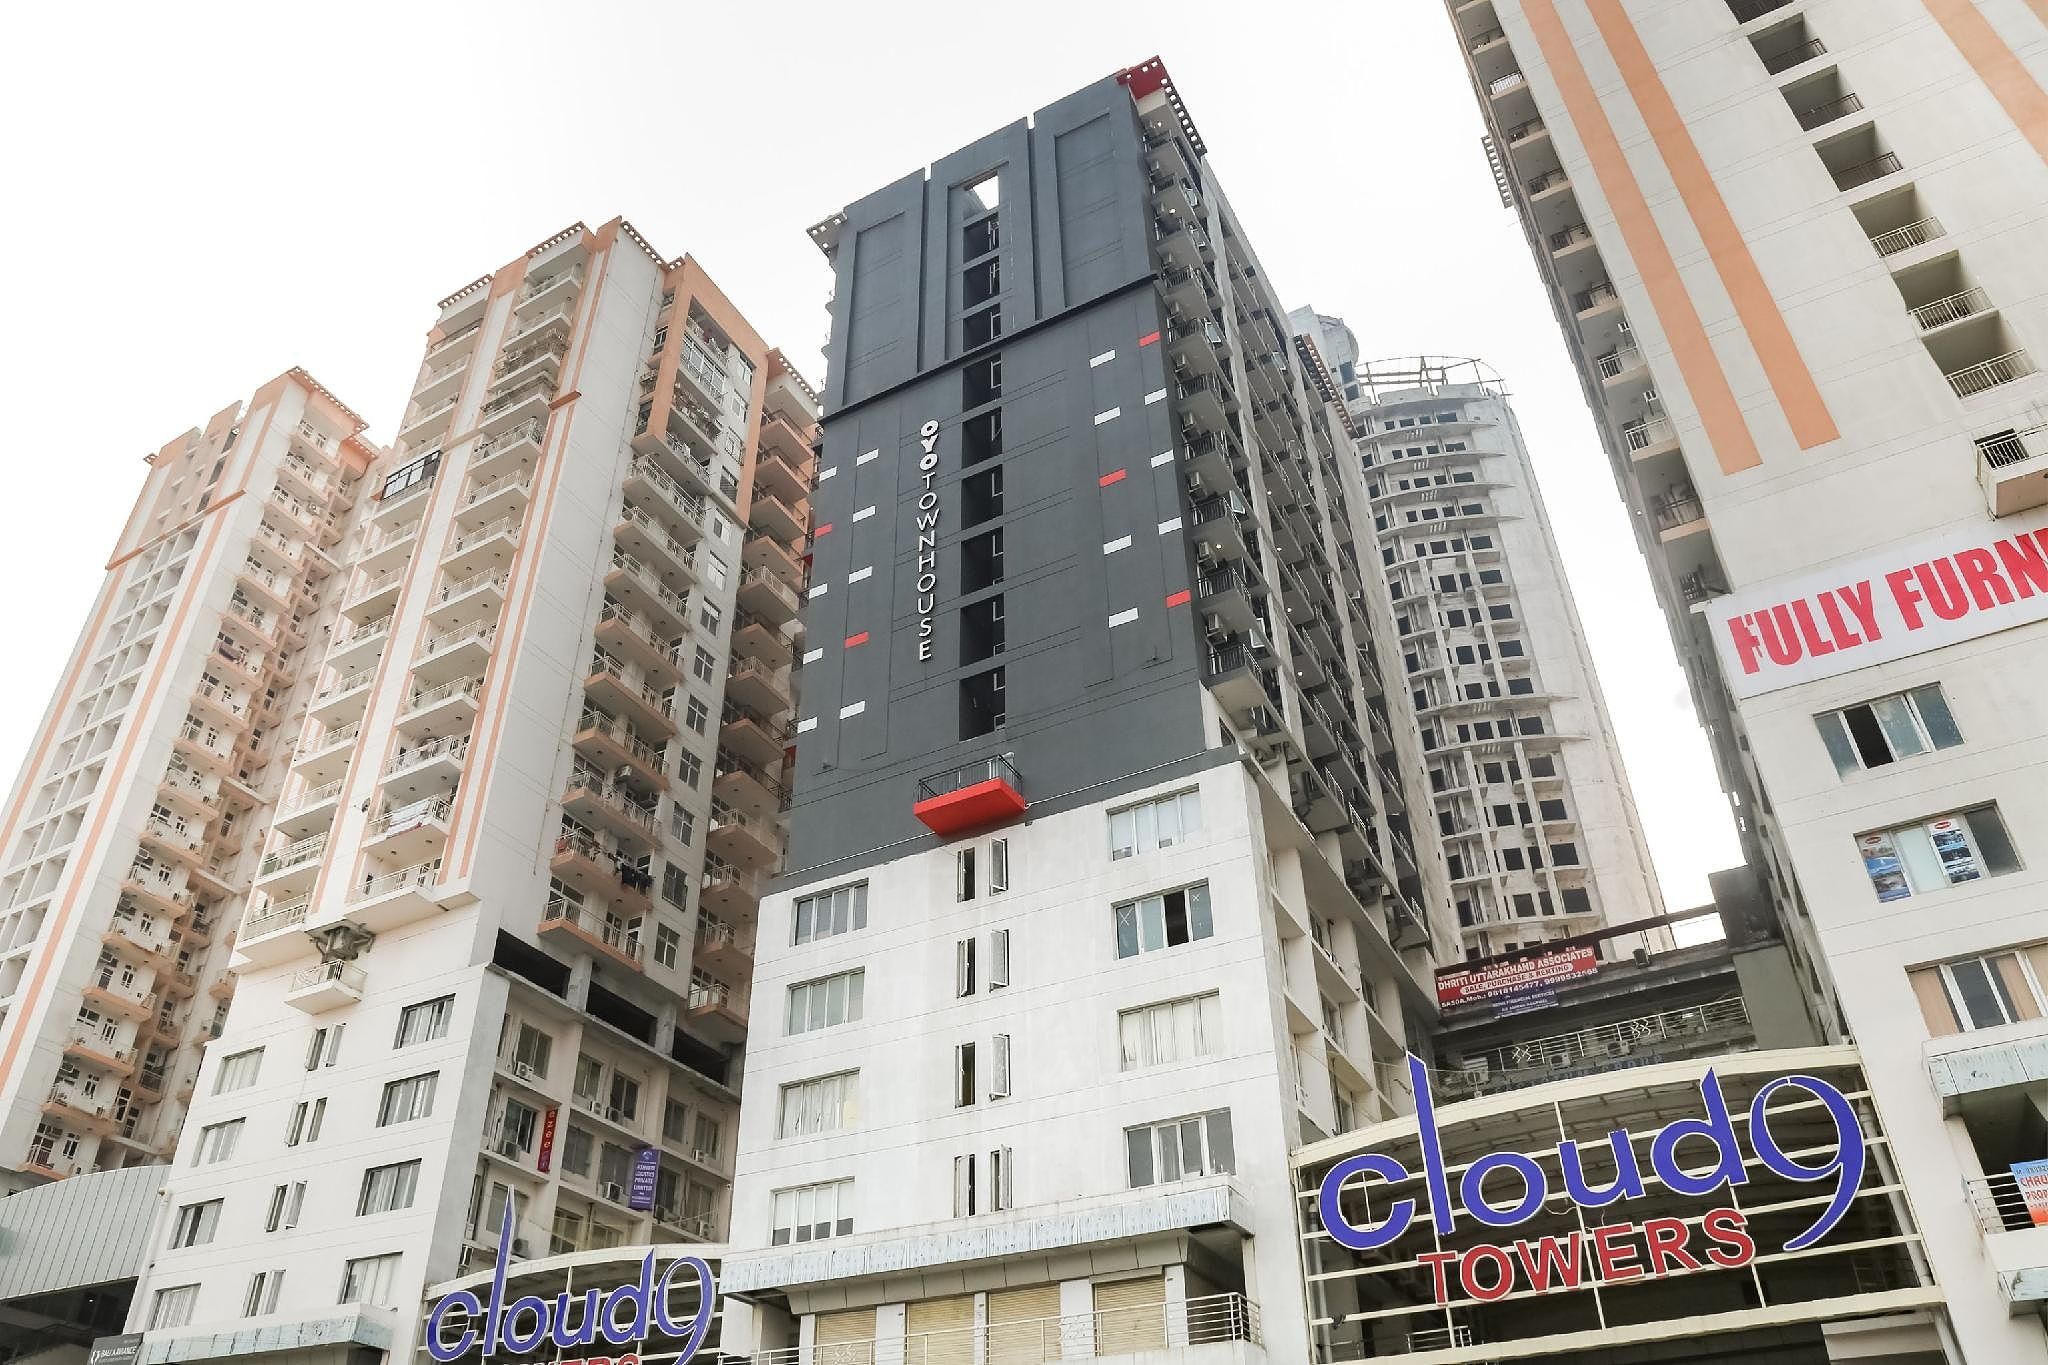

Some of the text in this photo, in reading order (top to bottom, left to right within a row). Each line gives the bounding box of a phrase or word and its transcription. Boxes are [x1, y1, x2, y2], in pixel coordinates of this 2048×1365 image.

[920, 419, 939, 471] OYO
[916, 471, 939, 662] TOWNHOUSE
[1728, 580, 1882, 674] FULLY
[1438, 977, 1468, 991] DHRITI
[1470, 961, 1535, 984] UTTARAKHAND
[1537, 948, 1593, 968] ASSOCIATES
[1416, 1206, 1757, 1306] TOWERS
